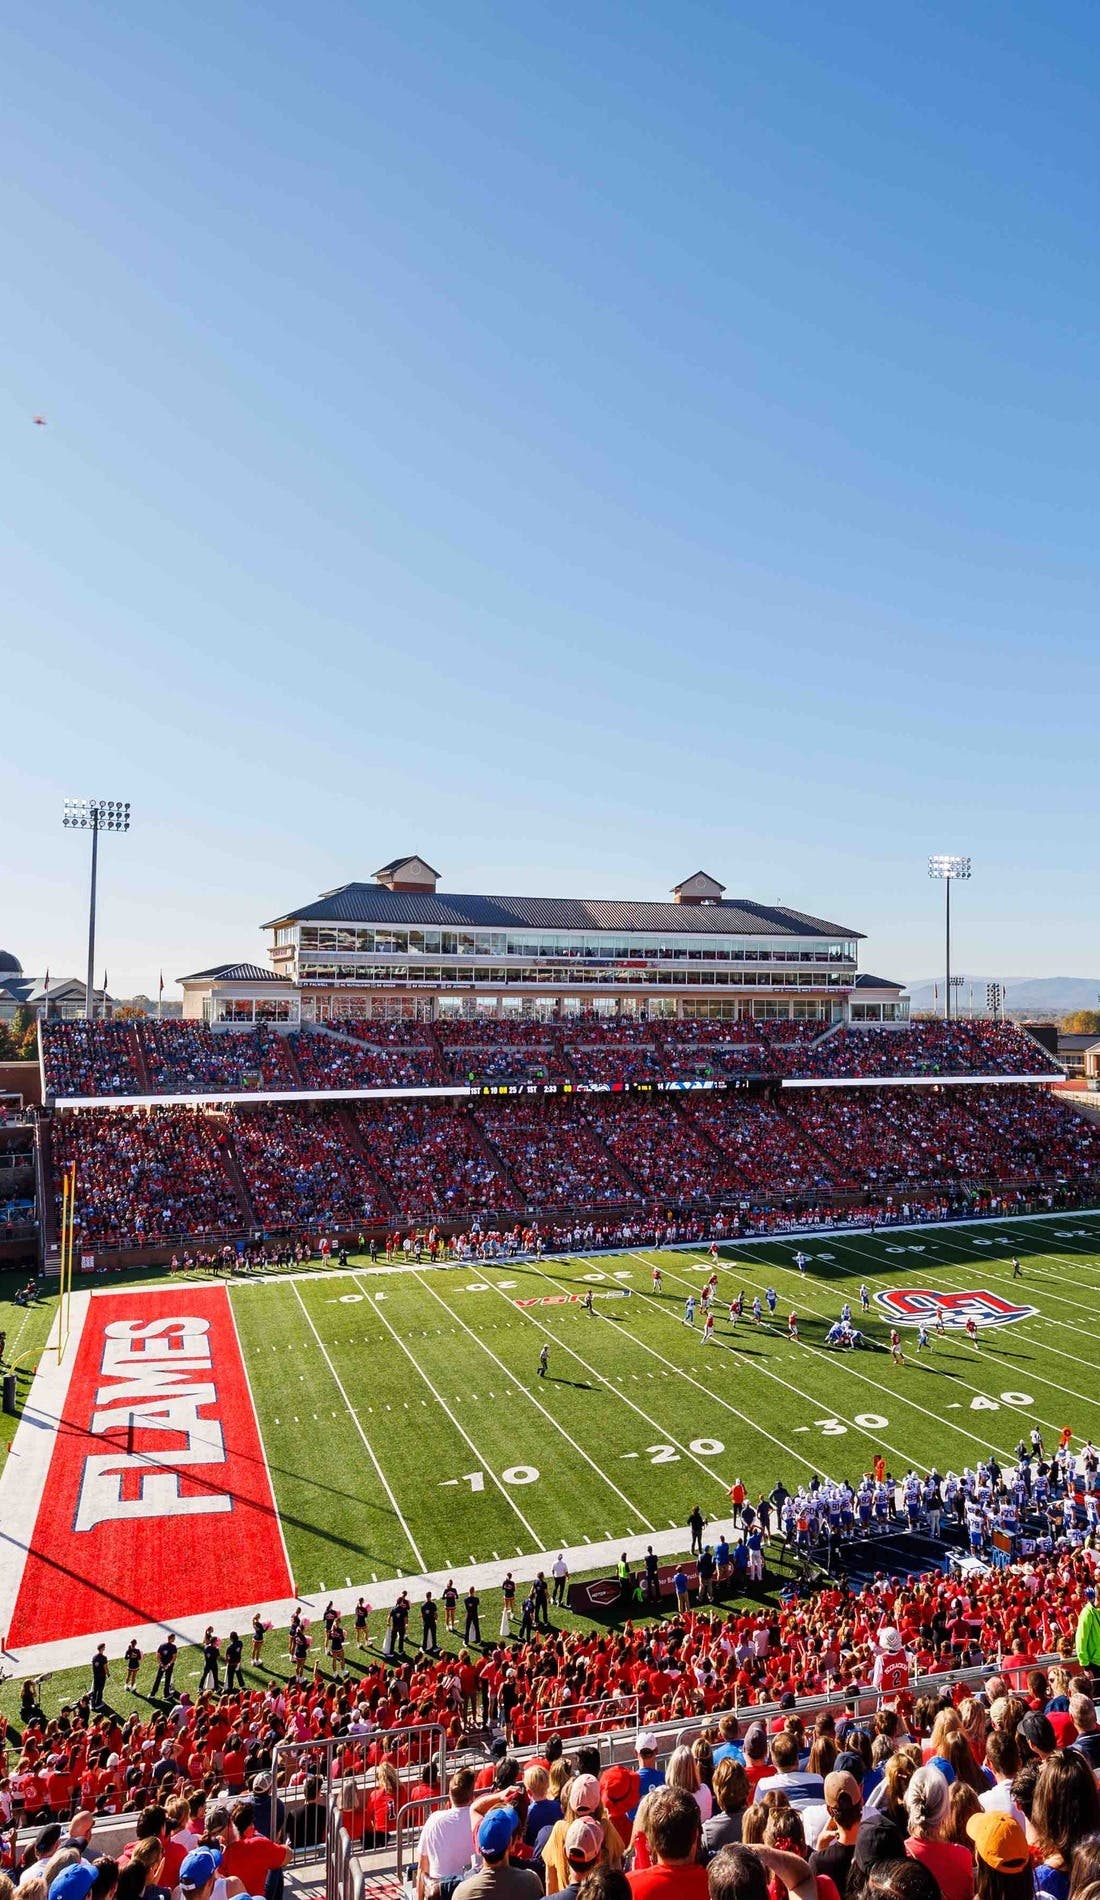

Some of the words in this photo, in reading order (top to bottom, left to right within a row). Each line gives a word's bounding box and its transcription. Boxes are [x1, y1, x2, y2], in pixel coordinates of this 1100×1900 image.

[470, 1087, 481, 1095] 1ST
[526, 1085, 538, 1093] 1ST
[970, 1391, 1034, 1411] 40
[73, 1316, 234, 1533] FLAMES
[814, 1414, 889, 1436] 30
[645, 1438, 725, 1464] 20
[462, 1465, 540, 1492] 10
[1004, 1510, 1015, 1518] 70
[892, 1670, 902, 1687] 2
